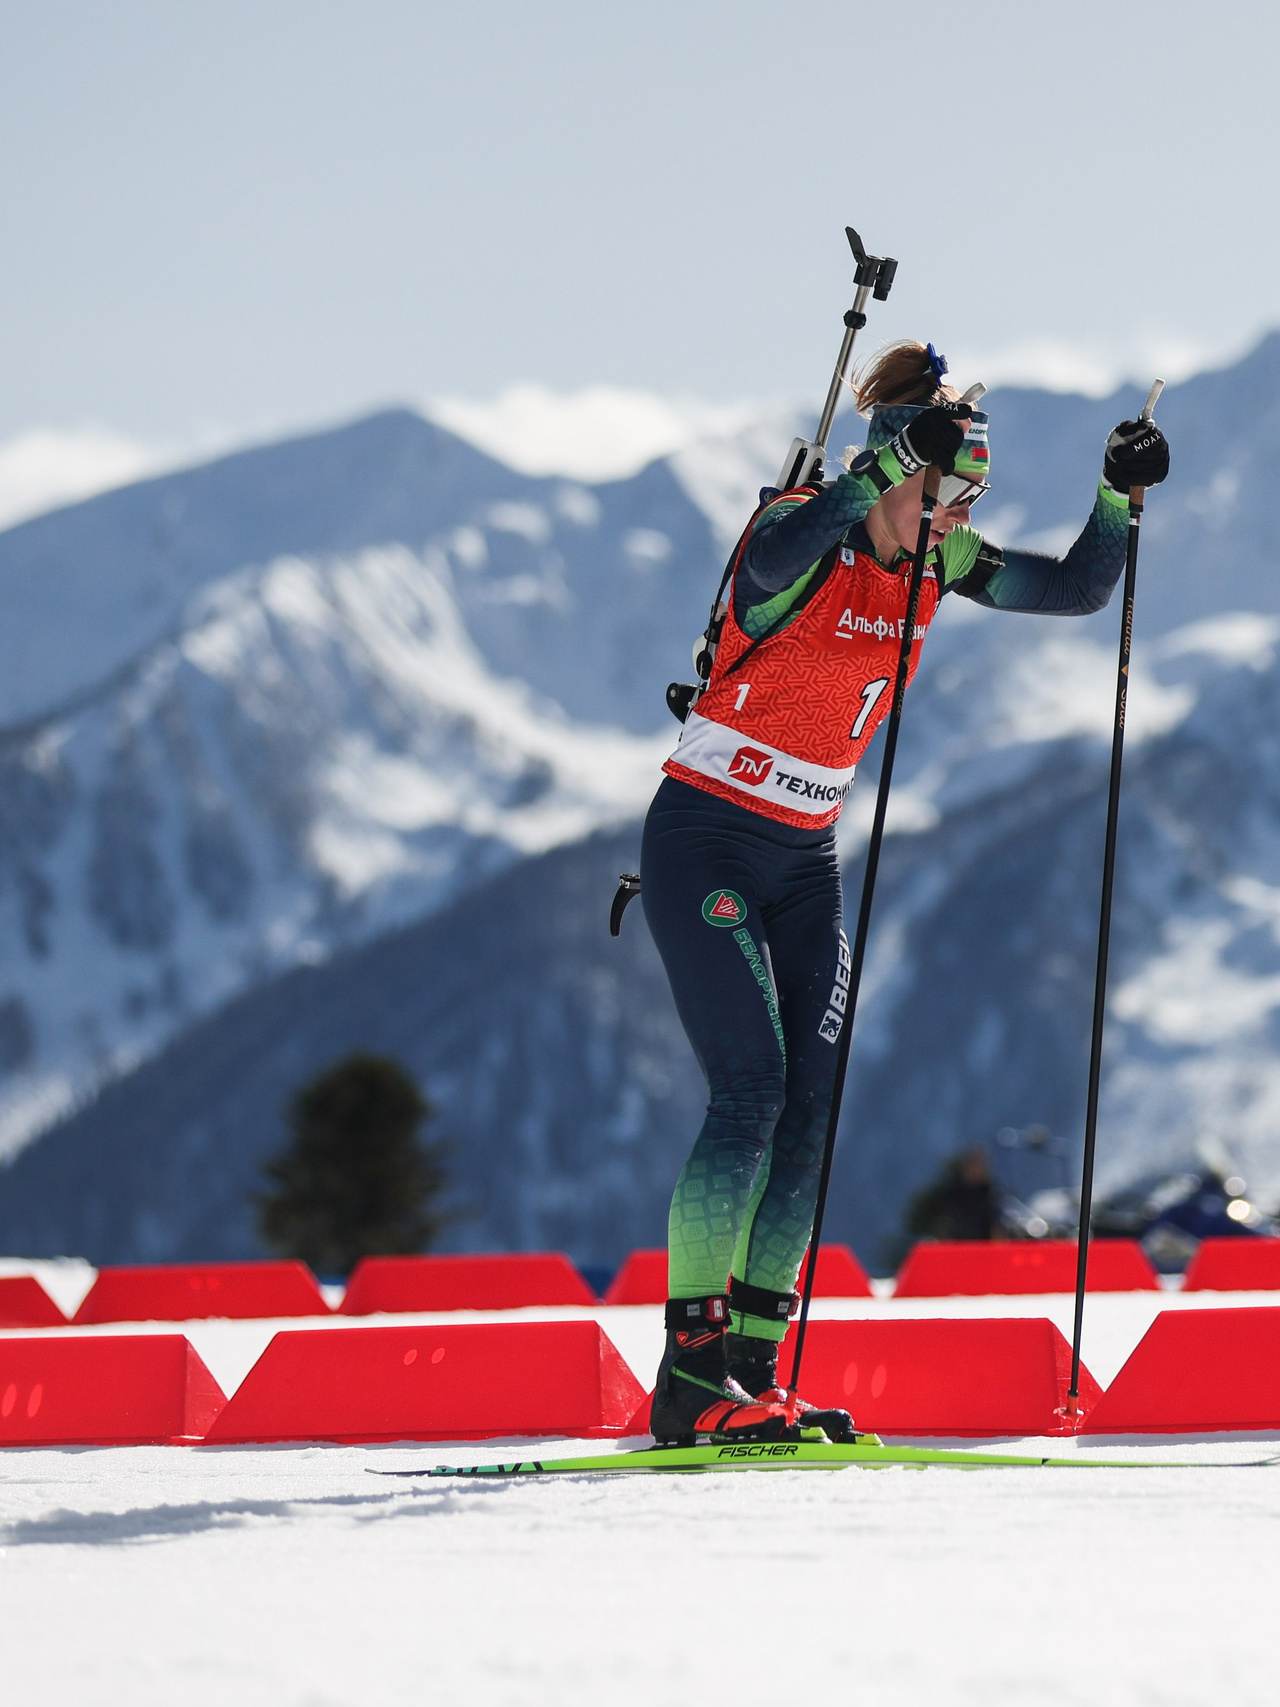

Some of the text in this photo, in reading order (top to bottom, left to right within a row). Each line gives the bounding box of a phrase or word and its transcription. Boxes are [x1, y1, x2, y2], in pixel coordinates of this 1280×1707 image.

[1134, 432, 1161, 452] MOAX
[837, 608, 896, 641] Альфа
[733, 683, 751, 711] 1
[850, 677, 891, 740] 1
[718, 1445, 799, 1458] FISCHER
